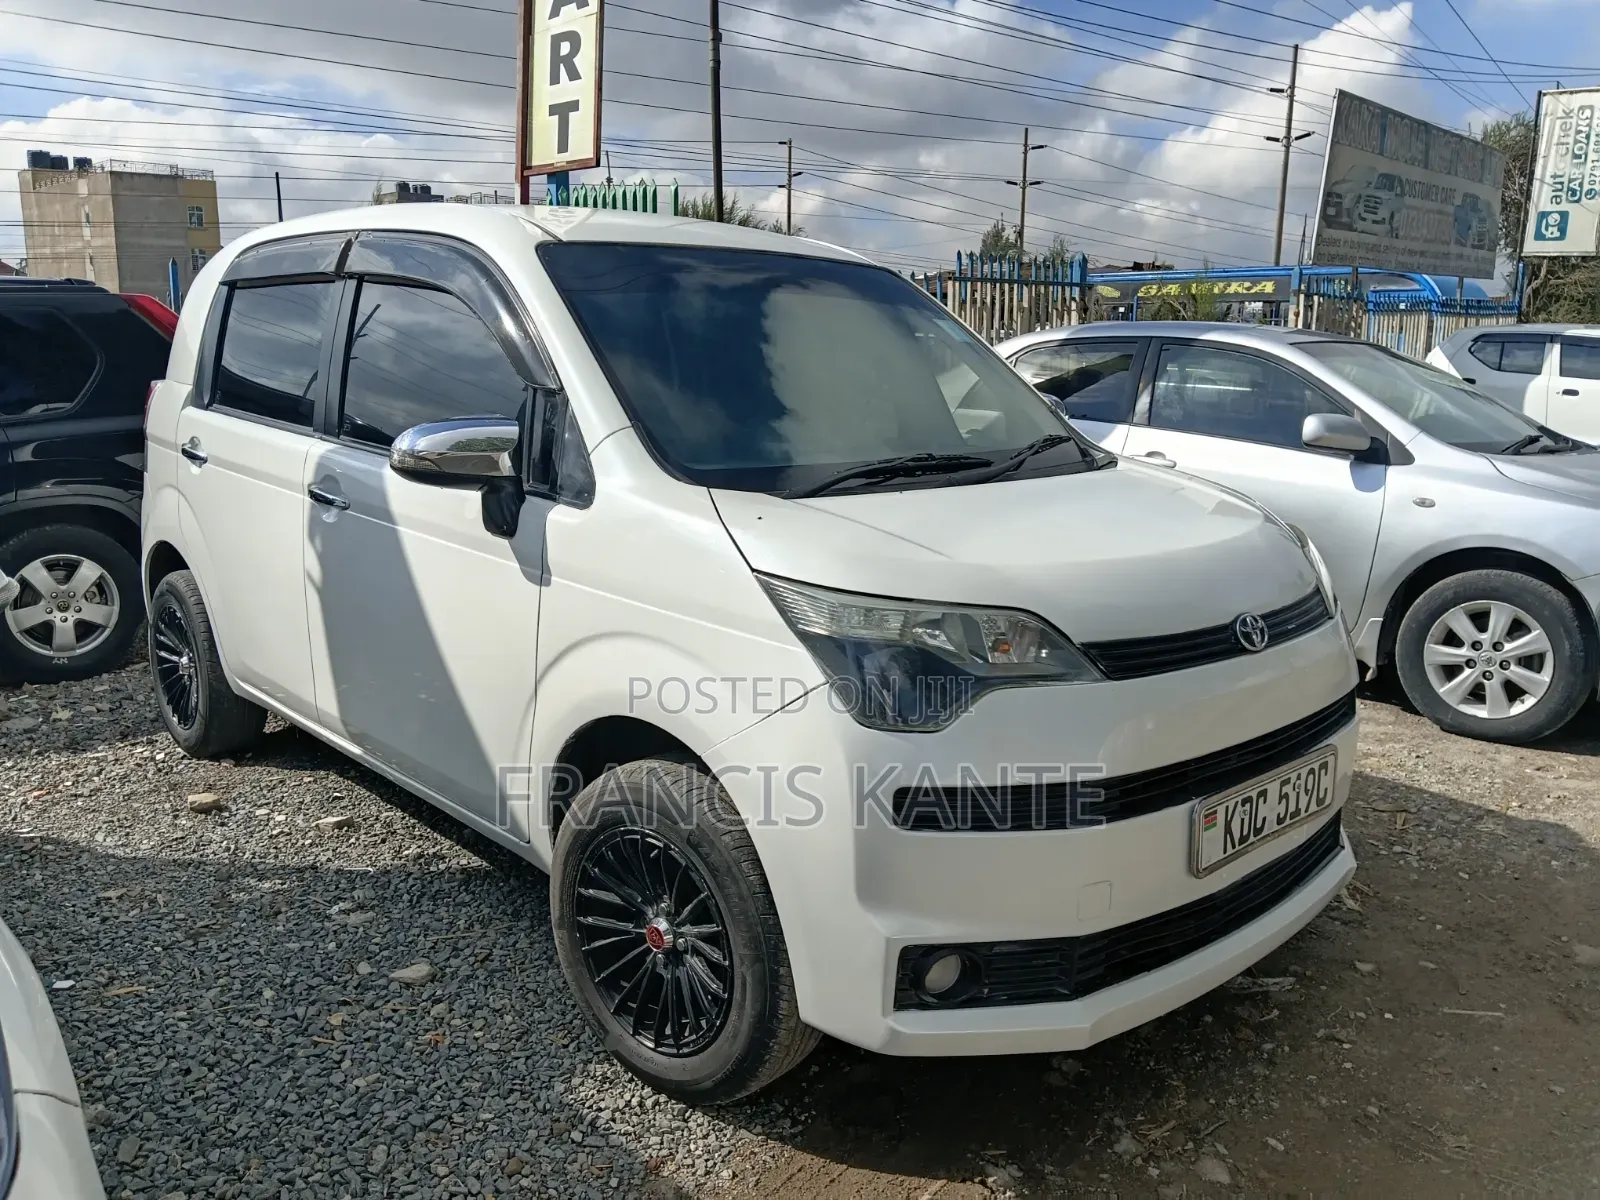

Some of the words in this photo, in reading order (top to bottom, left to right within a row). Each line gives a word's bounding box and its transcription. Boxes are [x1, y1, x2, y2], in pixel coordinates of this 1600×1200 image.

[1572, 107, 1592, 164] LOANS
[1404, 178, 1440, 203] CUSTOMER
[1440, 186, 1457, 206] CARE
[1567, 168, 1583, 201] CAR
[1223, 788, 1268, 855] KDC
[1276, 760, 1329, 826] 519C
